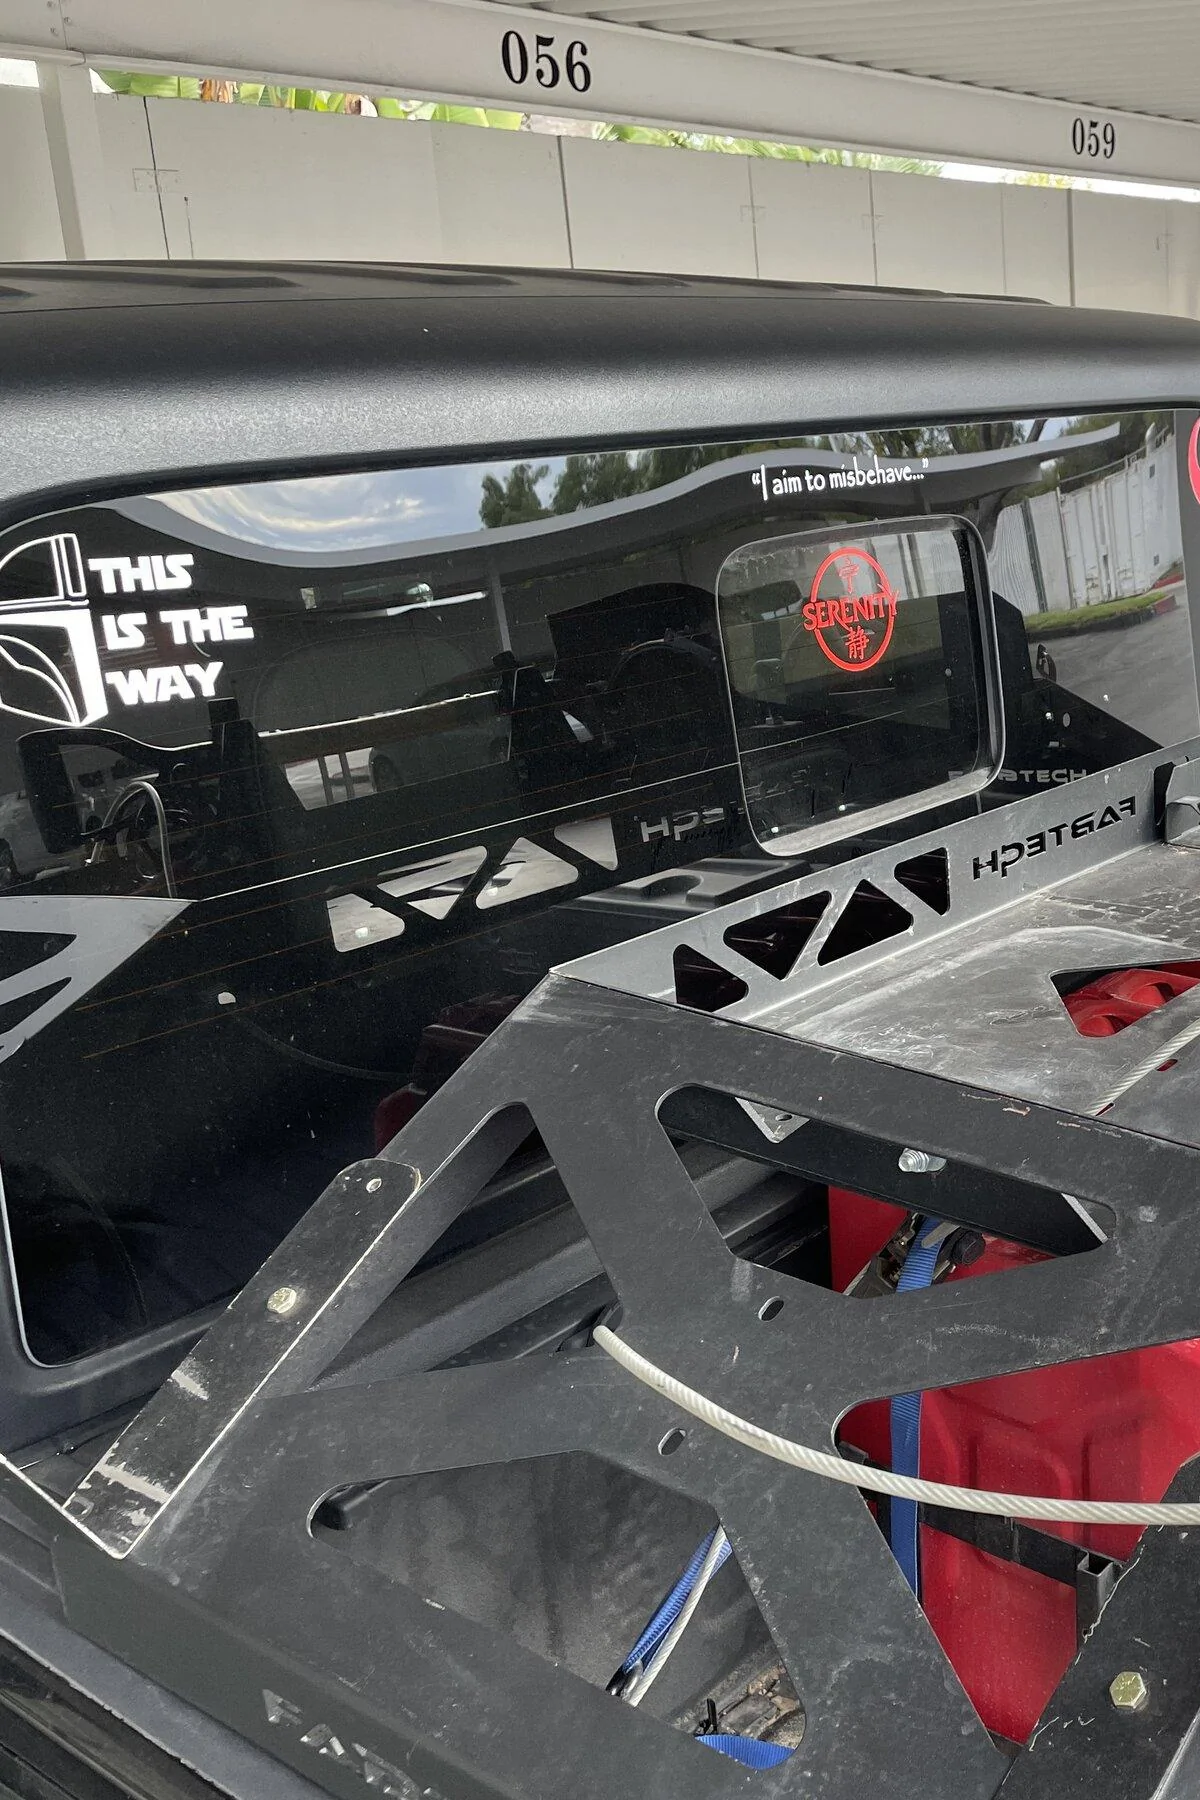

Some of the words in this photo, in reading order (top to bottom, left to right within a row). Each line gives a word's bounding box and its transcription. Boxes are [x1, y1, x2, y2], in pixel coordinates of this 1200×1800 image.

[502, 30, 592, 94] 056
[1072, 118, 1116, 160] 059
[772, 469, 802, 495] aim
[805, 469, 826, 491] to
[88, 553, 194, 594] THIS
[102, 612, 148, 651] IS
[159, 605, 254, 645] THE
[802, 584, 900, 632] SERENITY
[105, 661, 223, 705] WAY
[948, 768, 1087, 784] FBTECH
